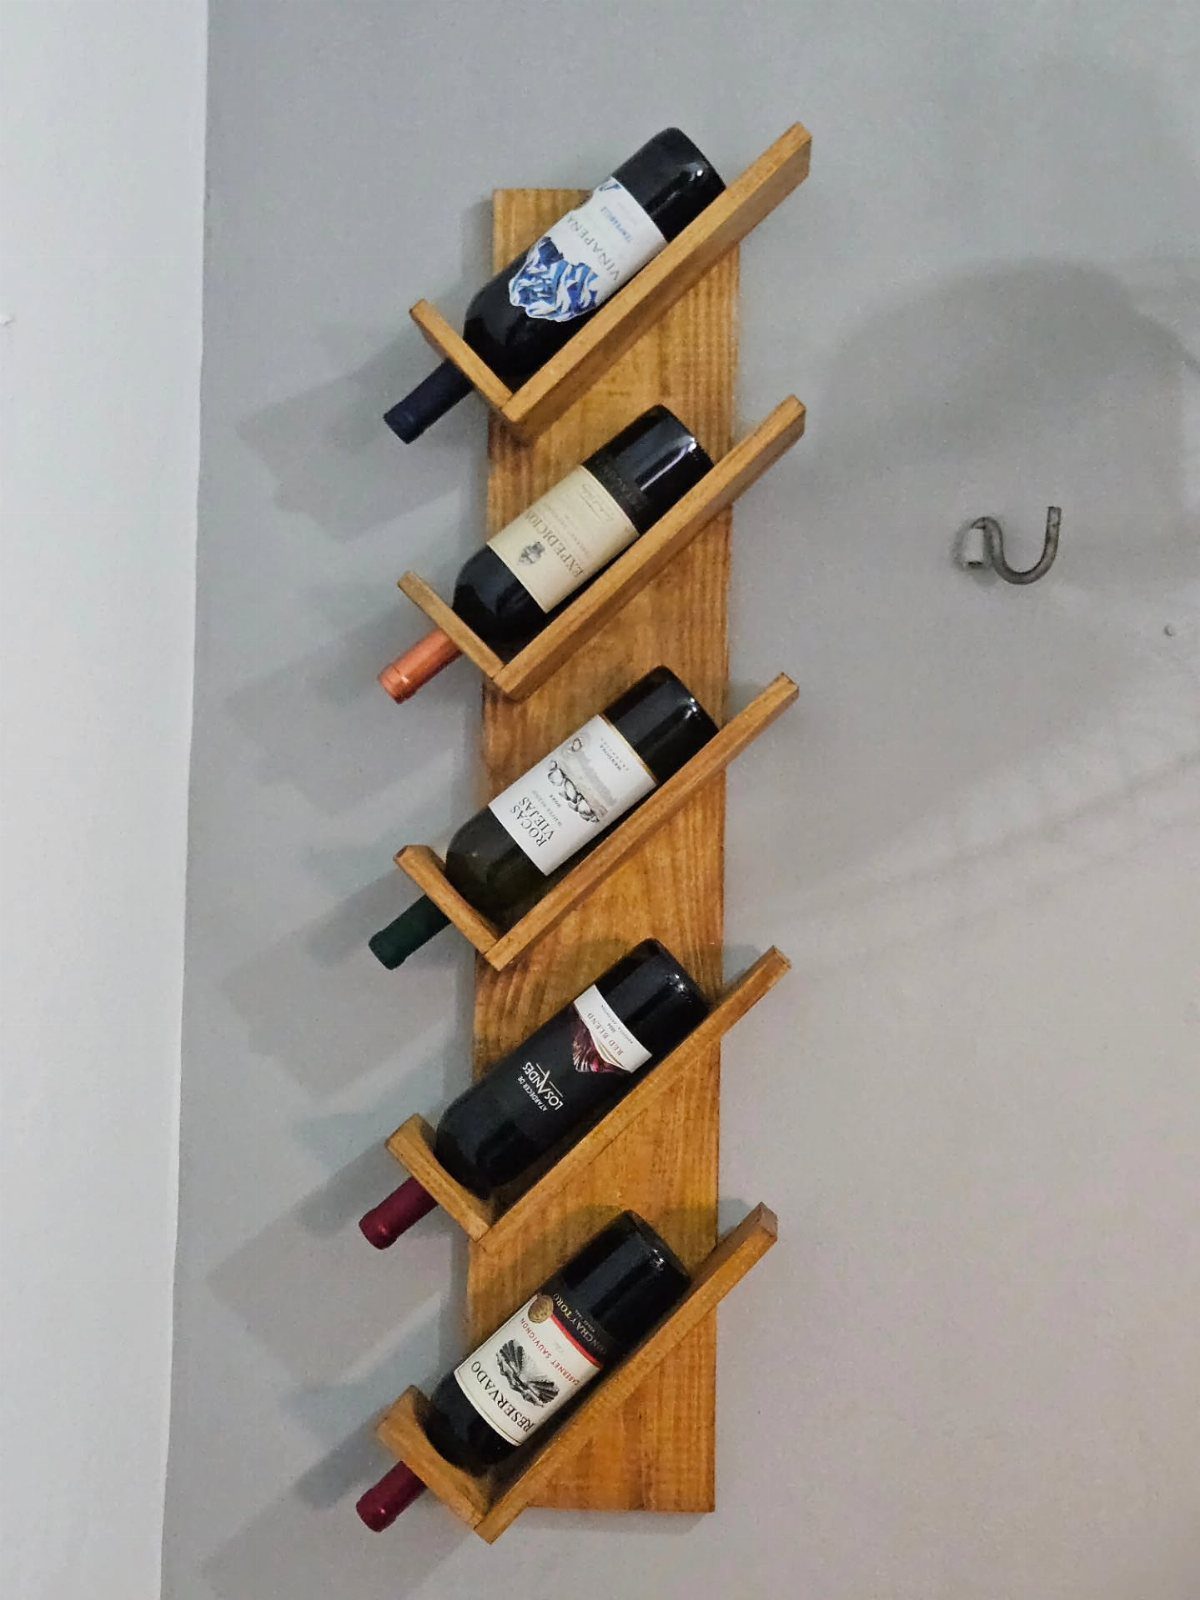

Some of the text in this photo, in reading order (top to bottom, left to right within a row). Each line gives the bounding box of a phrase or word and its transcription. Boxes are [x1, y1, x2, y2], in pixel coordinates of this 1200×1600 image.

[510, 804, 547, 847] ROCAS
[519, 796, 554, 840] VIEJAS
[585, 1012, 609, 1039] BLEND
[607, 1038, 624, 1056] RED
[517, 1075, 548, 1111] ATARDECER DE
[519, 1317, 552, 1359] SAUVIGNON
[550, 1359, 579, 1385] CABERNET
[471, 1361, 534, 1432] RESERVADO
